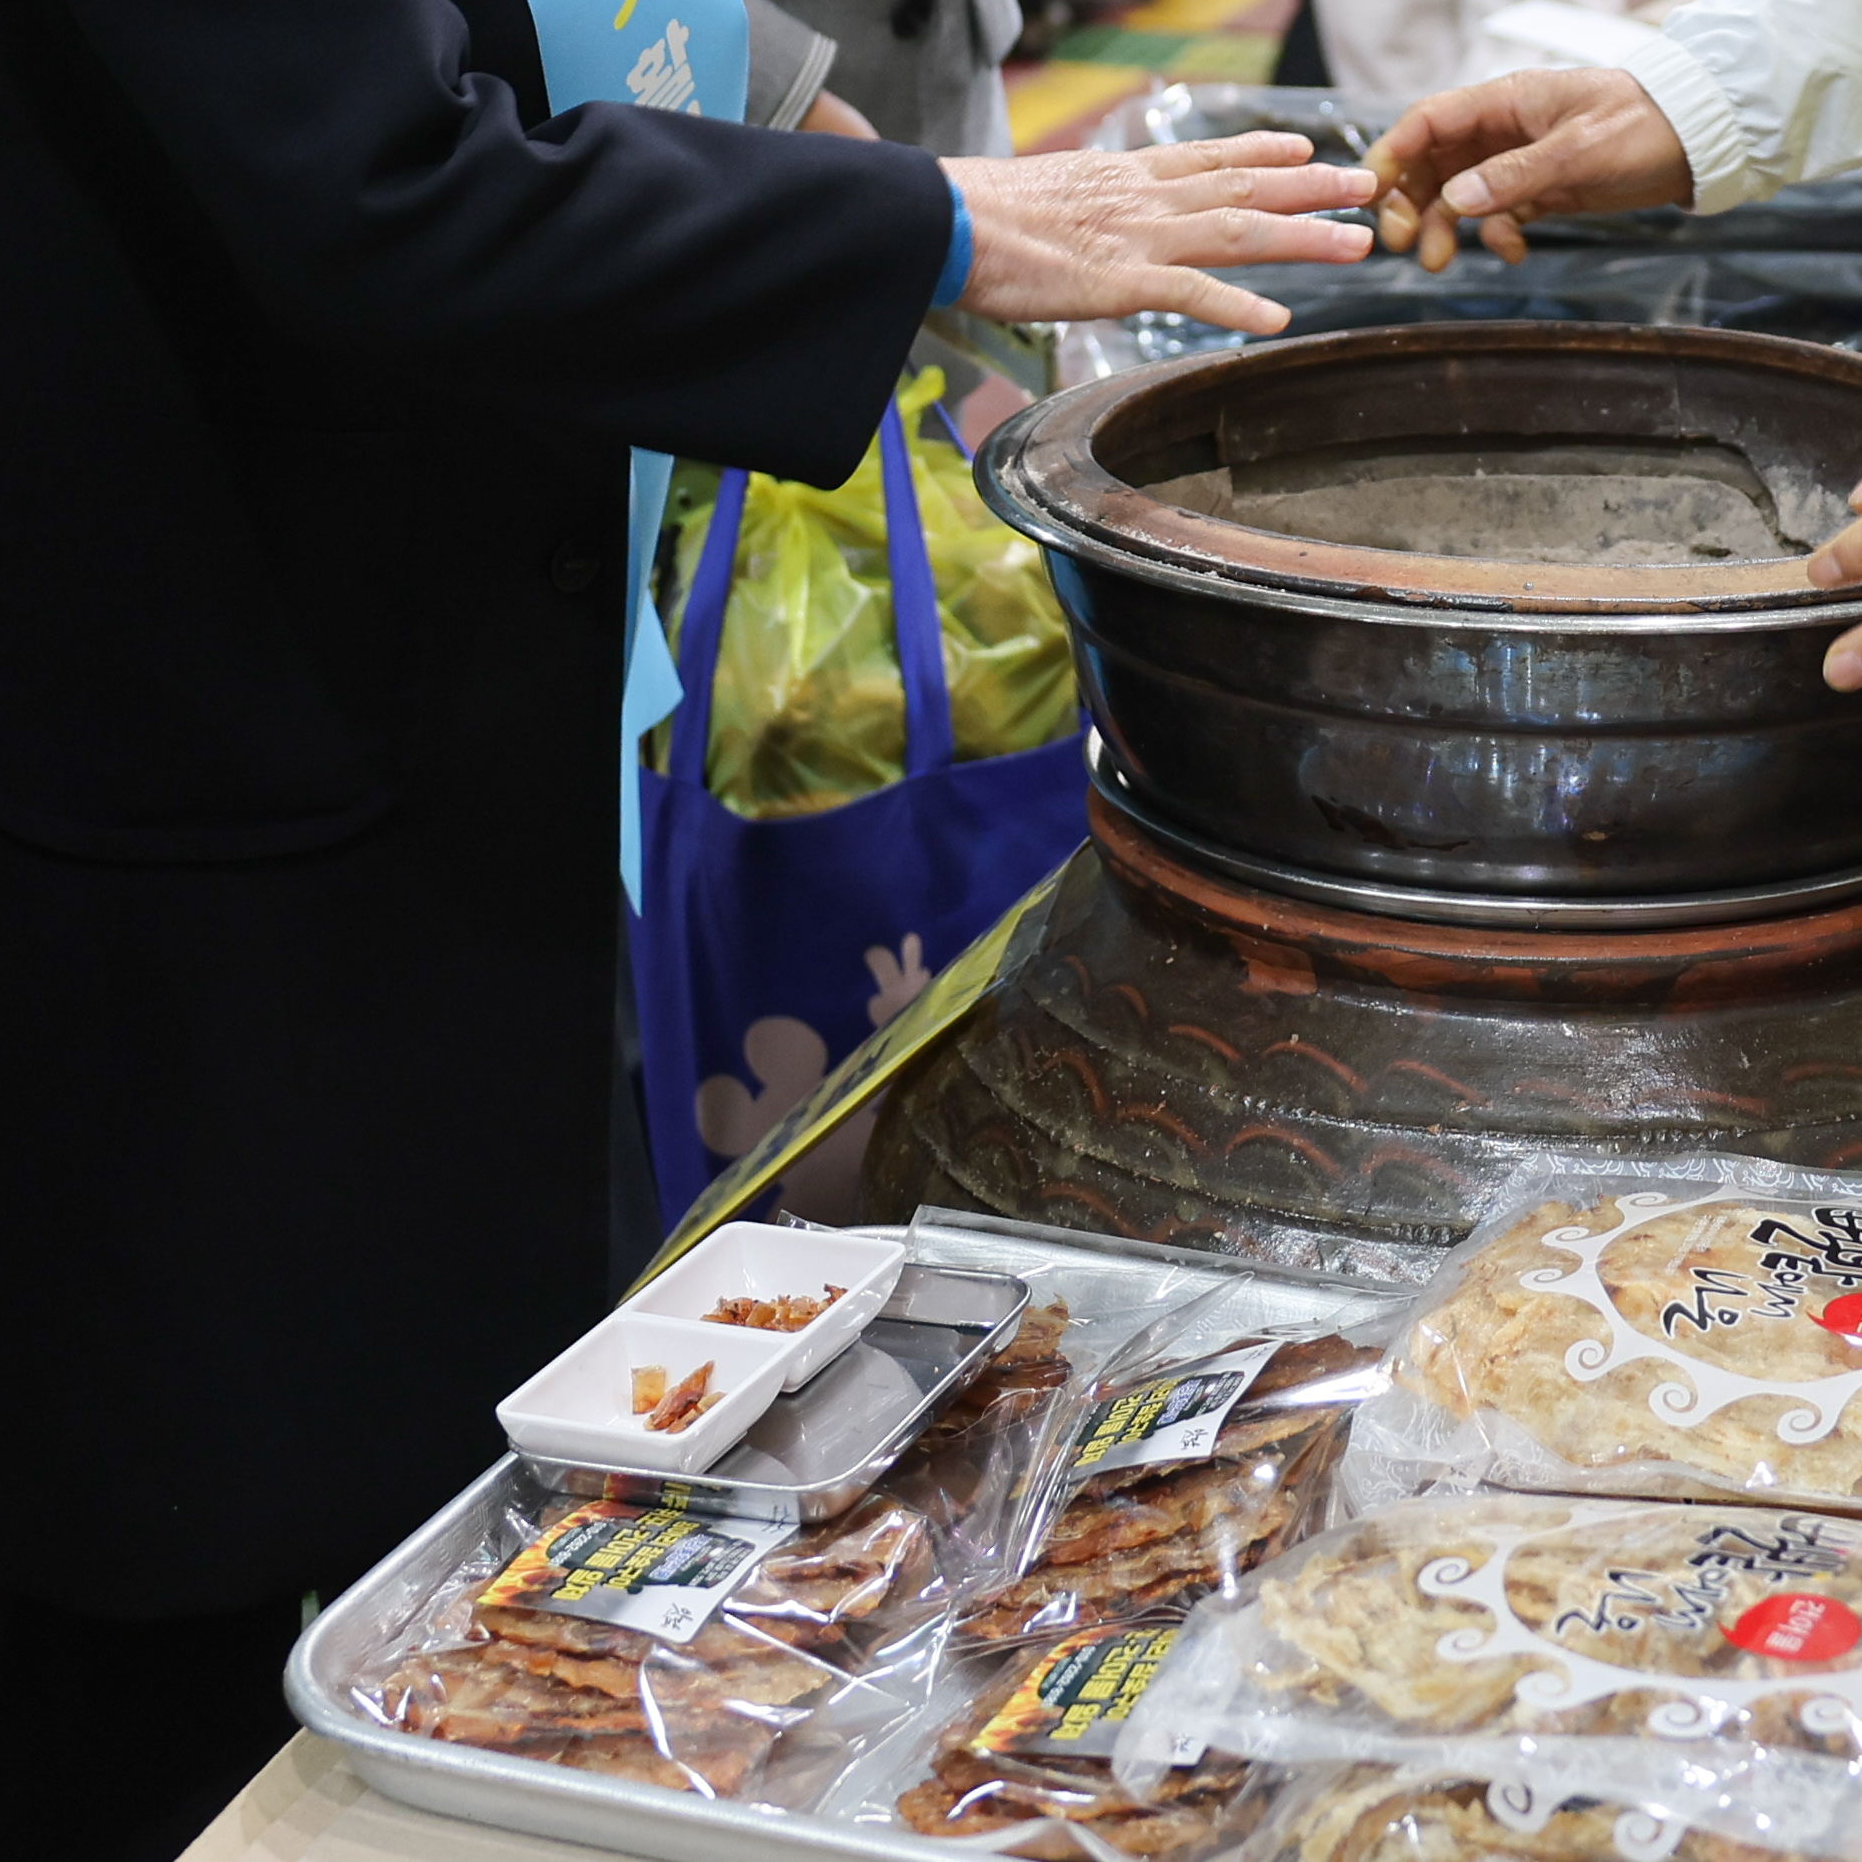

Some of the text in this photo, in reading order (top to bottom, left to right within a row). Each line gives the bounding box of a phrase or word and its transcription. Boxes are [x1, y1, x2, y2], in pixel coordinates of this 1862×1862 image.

[554, 1569, 604, 1600] 일체
[607, 1546, 662, 1589] 참숯구이
[1763, 1597, 1826, 1654] 건어물
